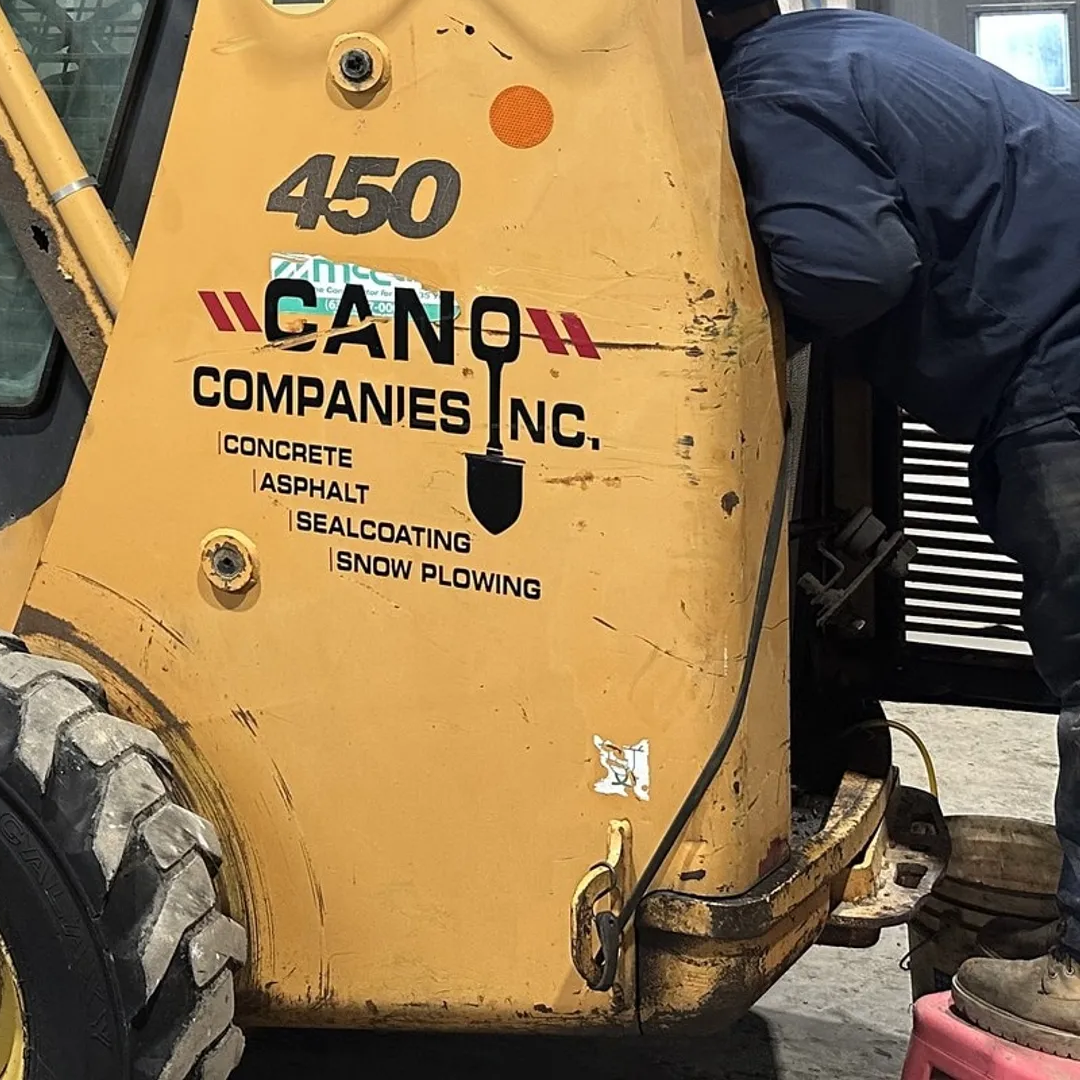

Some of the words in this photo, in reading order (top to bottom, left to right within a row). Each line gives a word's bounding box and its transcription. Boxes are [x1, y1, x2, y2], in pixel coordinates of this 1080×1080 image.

[266, 154, 461, 239] 450
[263, 278, 521, 365] CANO
[192, 366, 471, 435] COMPANIES
[223, 434, 353, 468] CONCRETE
[259, 472, 369, 504] ASPHALT
[296, 510, 471, 553] SEALCOATING
[336, 550, 412, 581] SNOW
[420, 562, 542, 600] PLOWING
